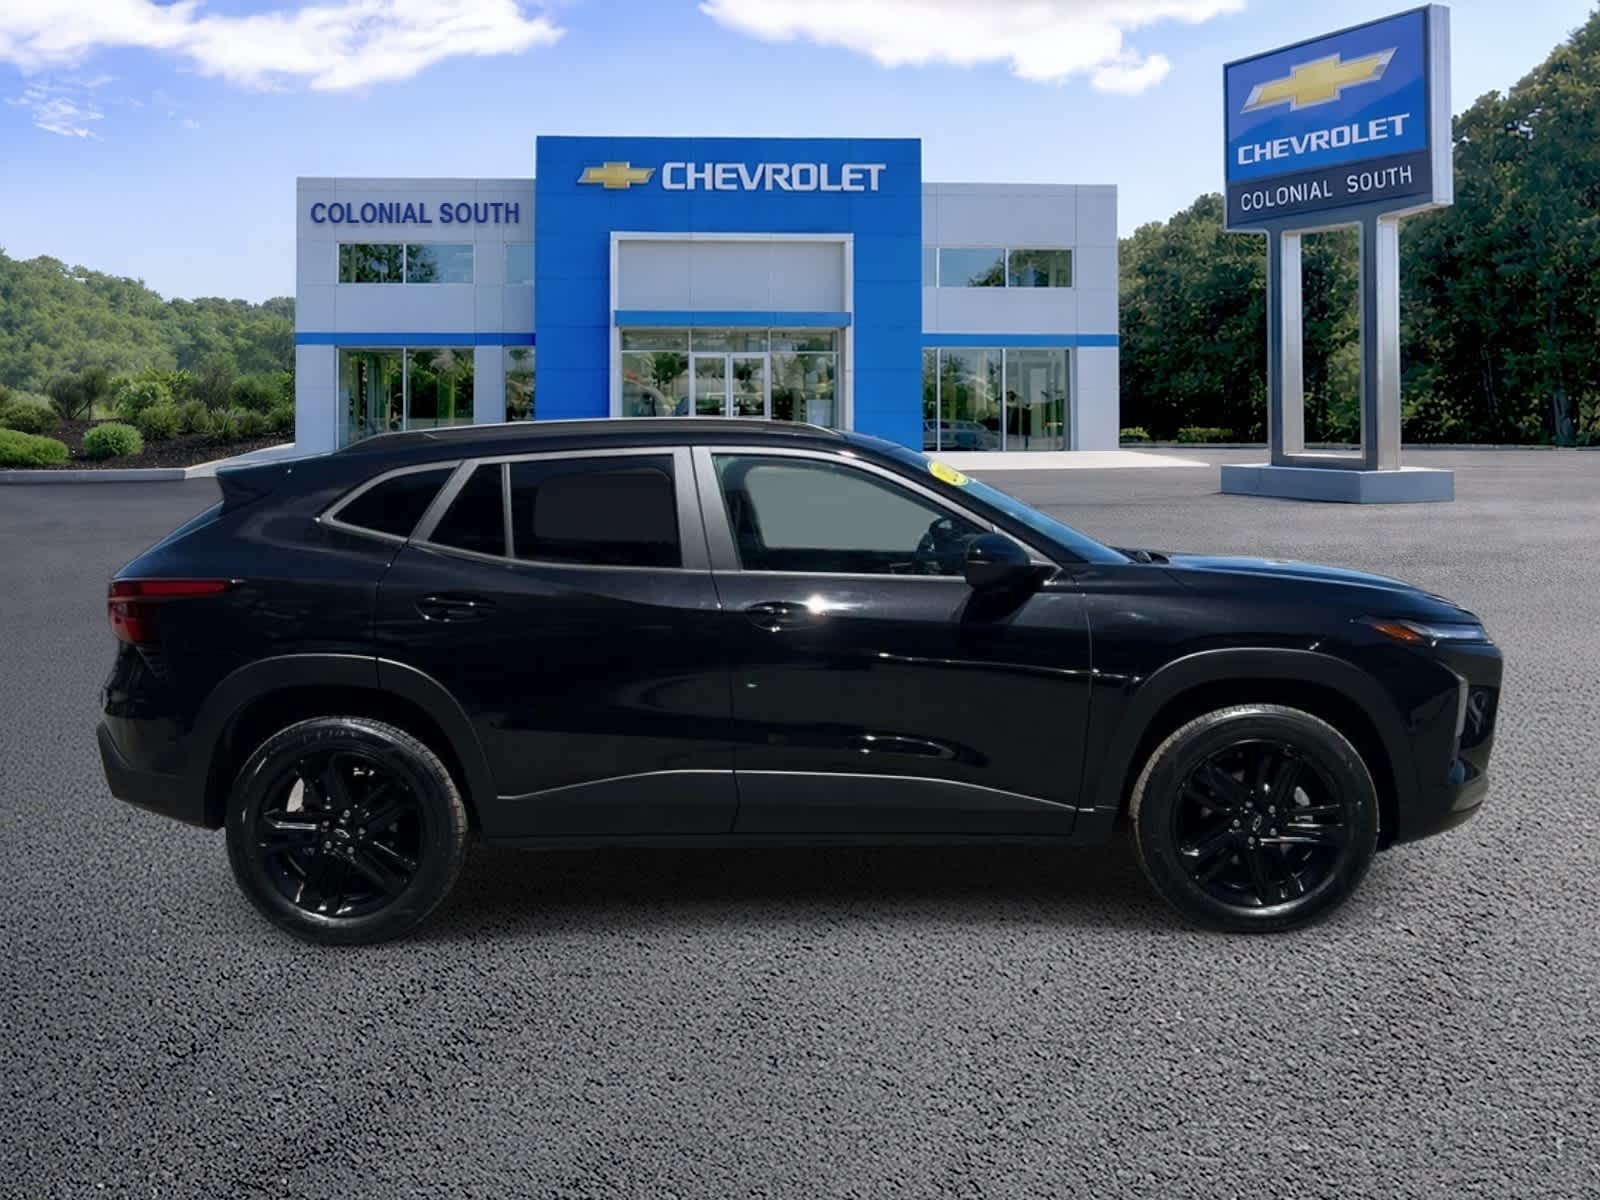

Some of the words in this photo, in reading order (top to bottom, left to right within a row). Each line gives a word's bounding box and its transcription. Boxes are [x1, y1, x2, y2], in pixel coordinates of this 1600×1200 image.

[1237, 113, 1410, 165] CHEVROLET
[661, 161, 887, 192] CHEVROLET
[1240, 179, 1333, 212] COLONIAL
[1346, 165, 1413, 194] SOUTH
[310, 202, 432, 225] COLONIAL
[439, 202, 520, 225] SOUTH
